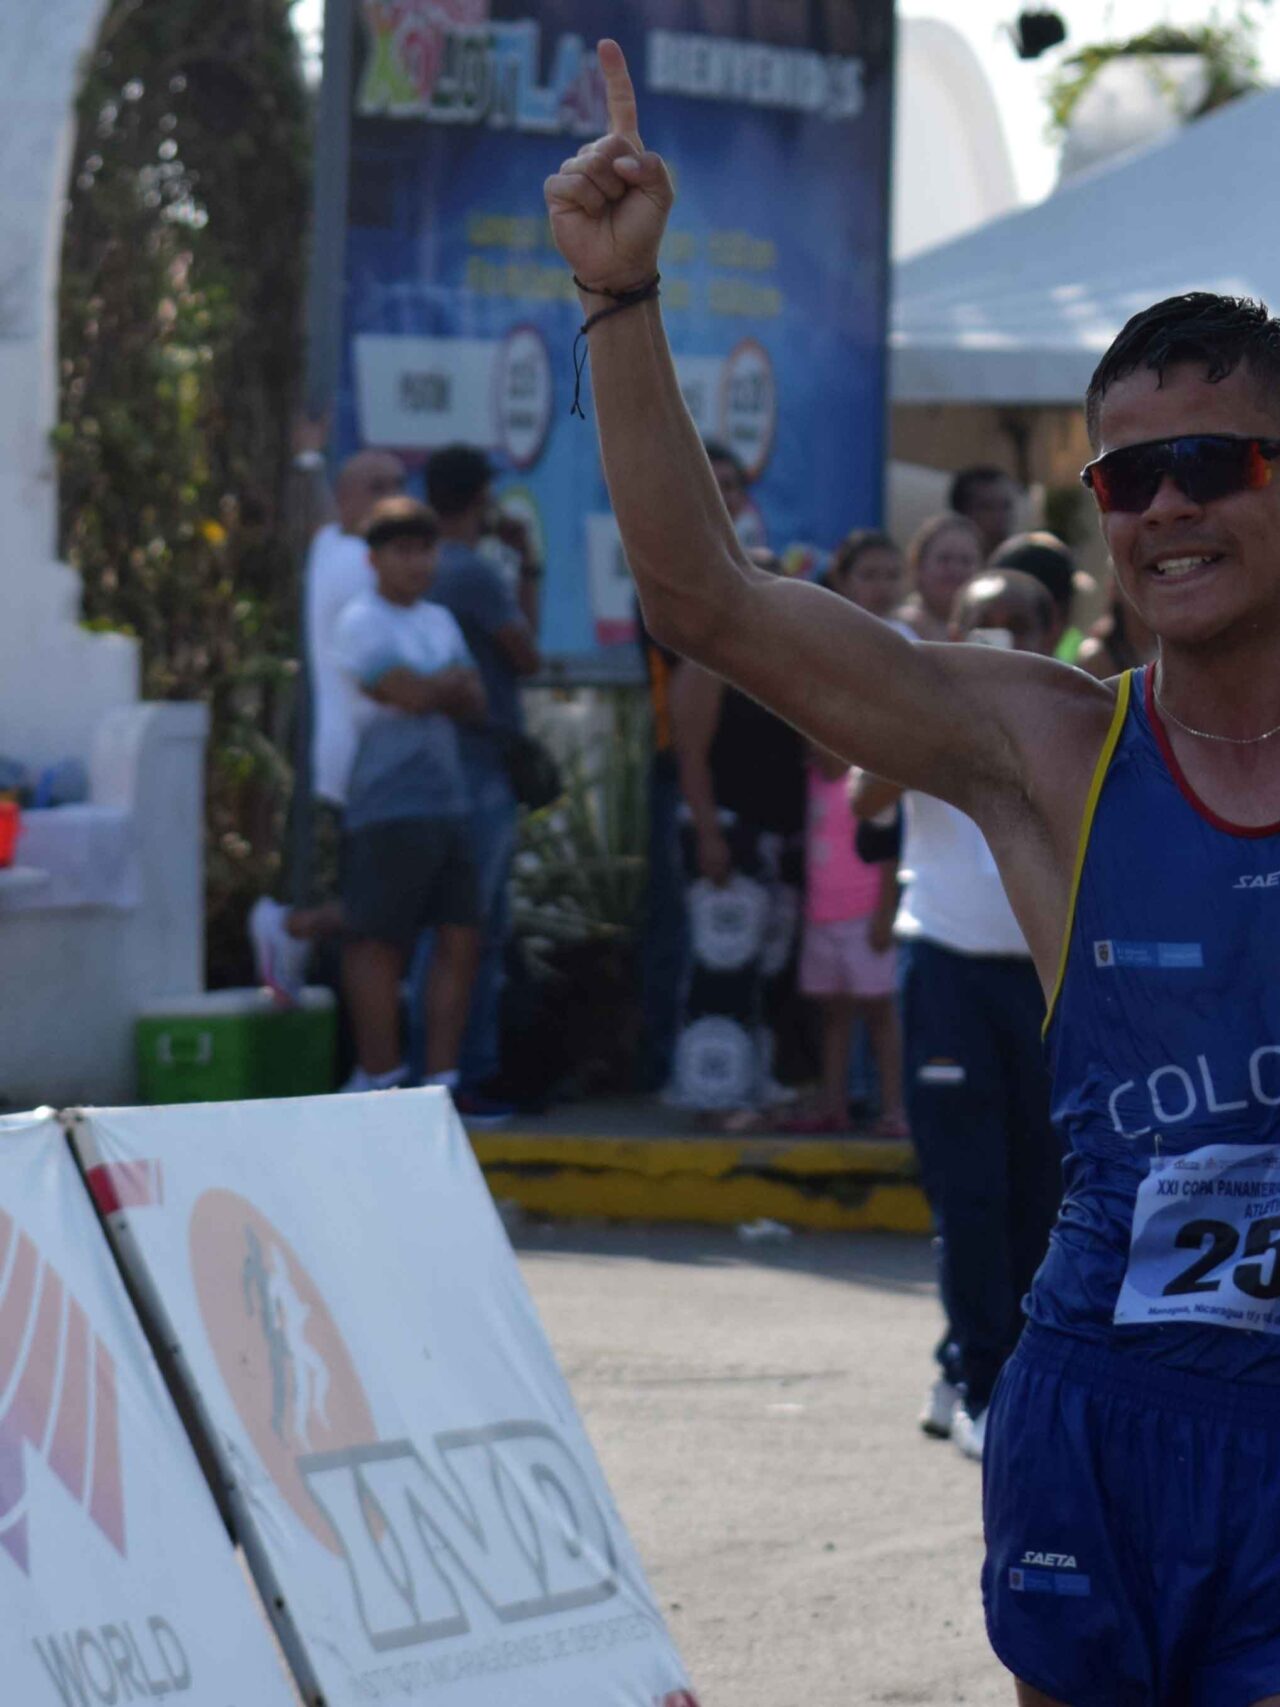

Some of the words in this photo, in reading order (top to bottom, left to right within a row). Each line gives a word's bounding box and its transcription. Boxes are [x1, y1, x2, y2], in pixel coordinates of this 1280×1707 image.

[357, 17, 612, 135] XOLOTLA
[1156, 1178, 1180, 1196] XXI
[1182, 1180, 1214, 1196] COPA
[1194, 1303, 1244, 1320] Nicaragua
[1020, 1551, 1077, 1568] SAETA
[31, 1614, 193, 1707] WORLD
